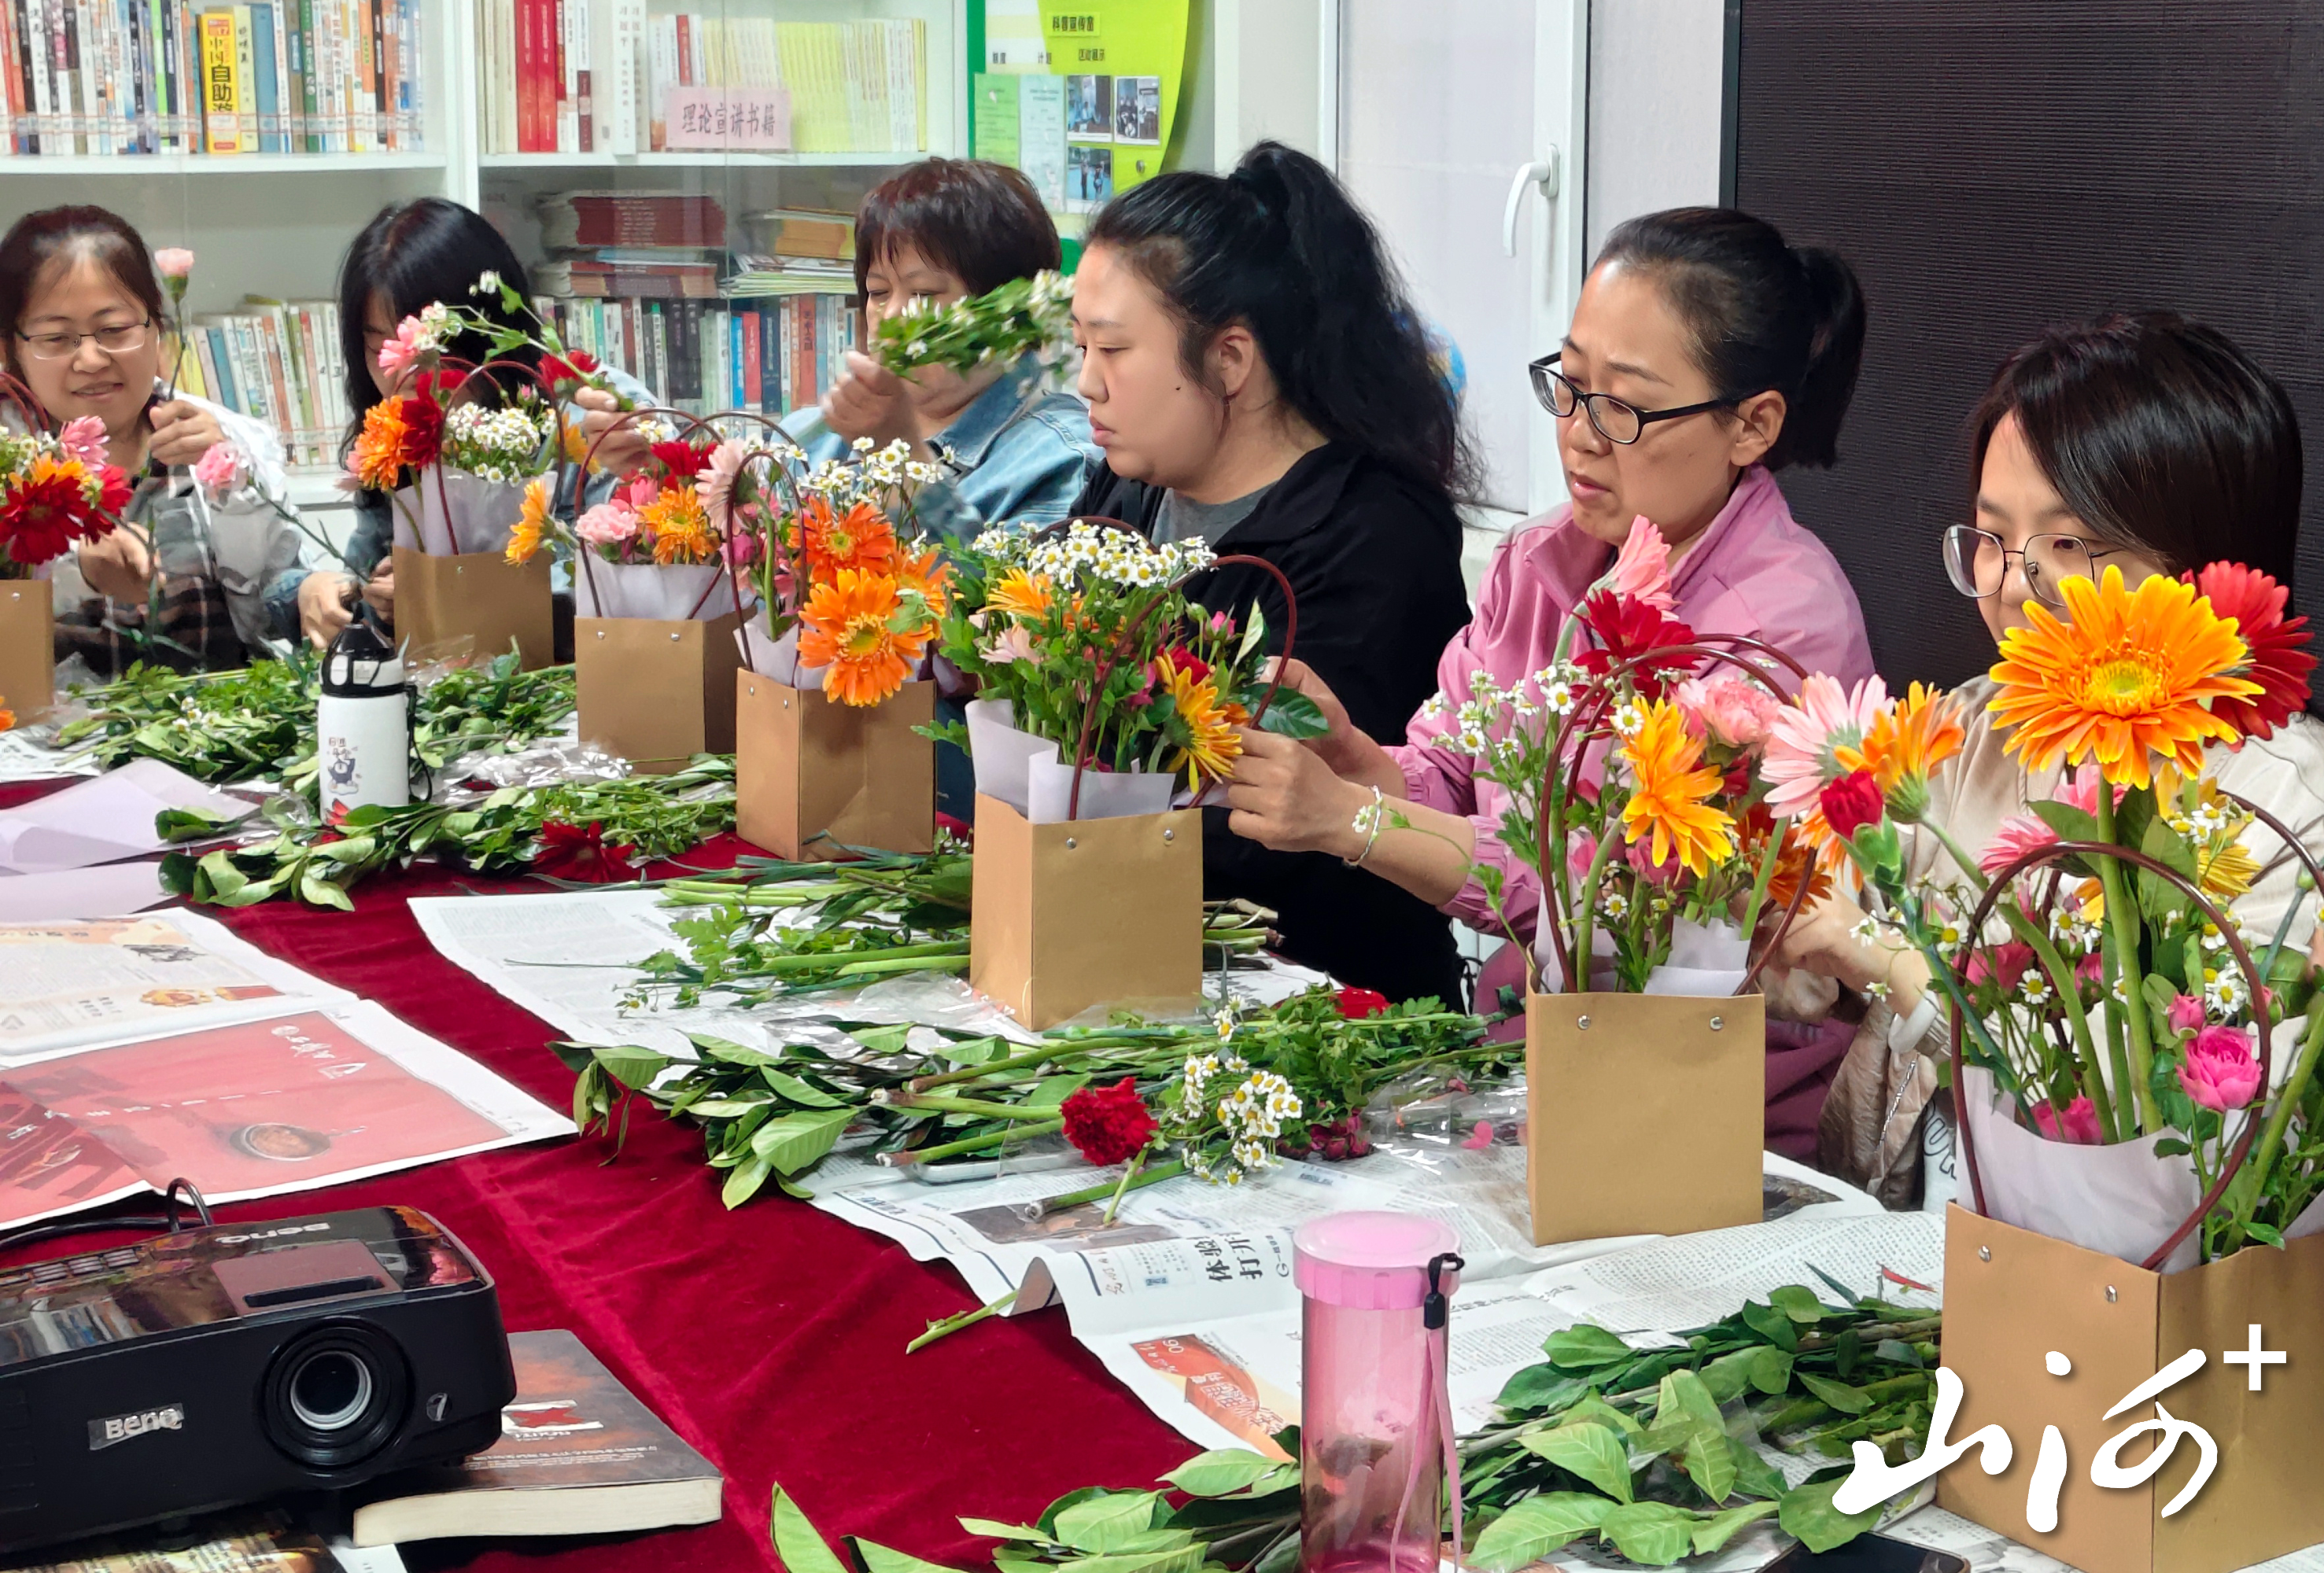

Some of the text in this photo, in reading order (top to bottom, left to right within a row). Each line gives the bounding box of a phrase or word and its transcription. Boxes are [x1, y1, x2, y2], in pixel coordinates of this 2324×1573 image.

[682, 102, 775, 138] 理论宣讲书籍
[1191, 1236, 1234, 1282] 体验
[1223, 1232, 1263, 1280] 打开
[105, 1408, 183, 1439] BenQ
